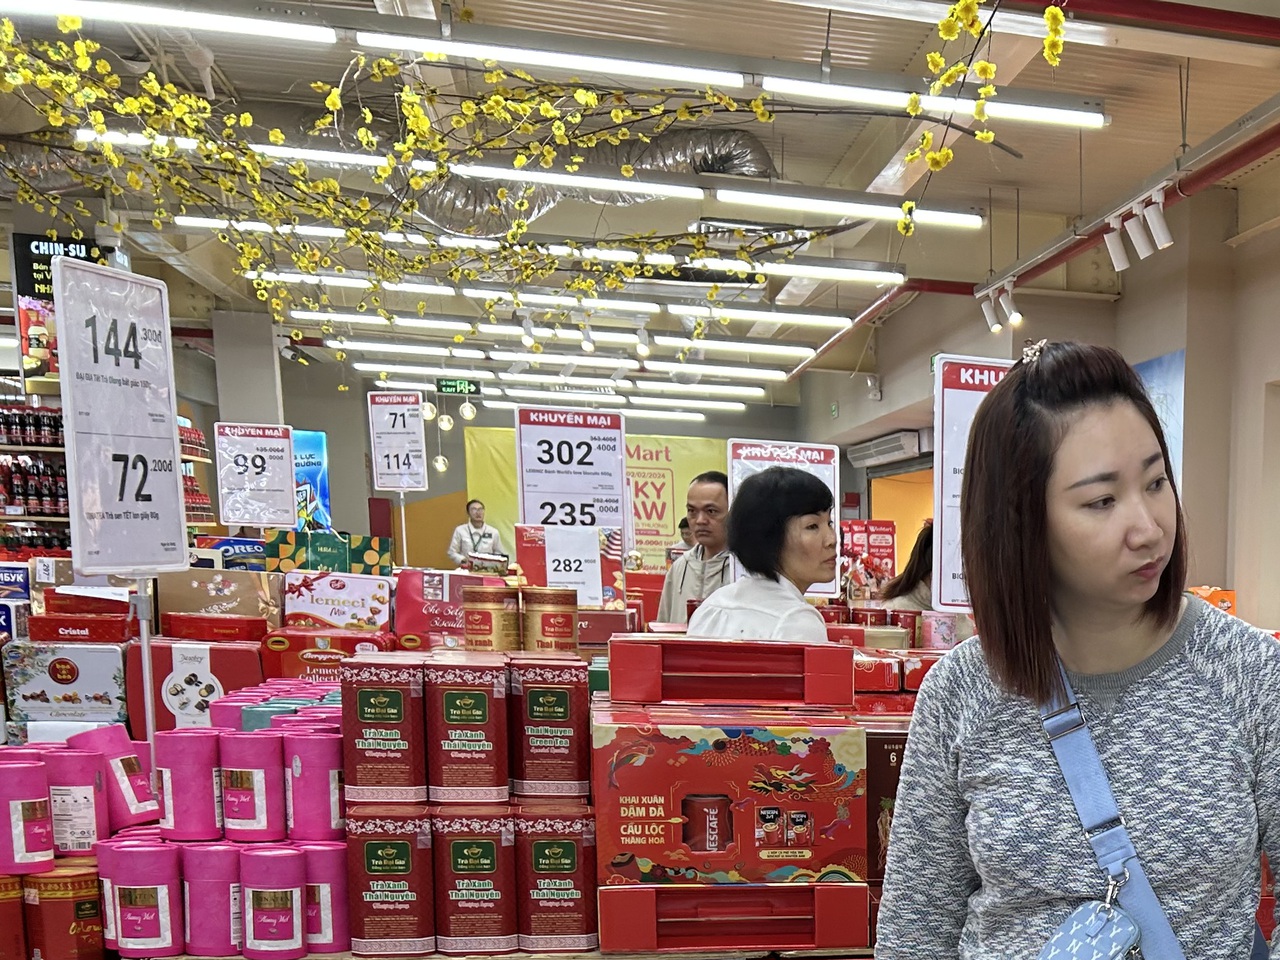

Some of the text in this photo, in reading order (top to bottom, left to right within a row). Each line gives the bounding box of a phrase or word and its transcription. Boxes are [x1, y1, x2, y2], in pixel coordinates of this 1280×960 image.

[30, 241, 87, 257] CHIN-SU
[85, 315, 142, 369] 144
[389, 412, 406, 429] 71
[530, 411, 611, 428] KHUYẾN MẠI
[536, 439, 616, 466] 302 .400đ
[234, 454, 266, 475] 99
[384, 453, 411, 470] 114
[112, 454, 173, 502] 72 .200đ
[540, 502, 596, 526] 235
[220, 545, 264, 556] OREO
[552, 559, 583, 573] 282
[58, 627, 90, 636] Cristal
[378, 729, 401, 738] Xanh
[463, 731, 485, 740] Xanh
[620, 795, 664, 804] KHAI XUÂN
[621, 804, 665, 819] ĐẬM ĐÀ
[645, 823, 665, 836] LỘC
[648, 837, 665, 845] HOA
[386, 882, 408, 890] Xanh
[472, 880, 493, 889] Xanh
[553, 880, 574, 889] Xanh
